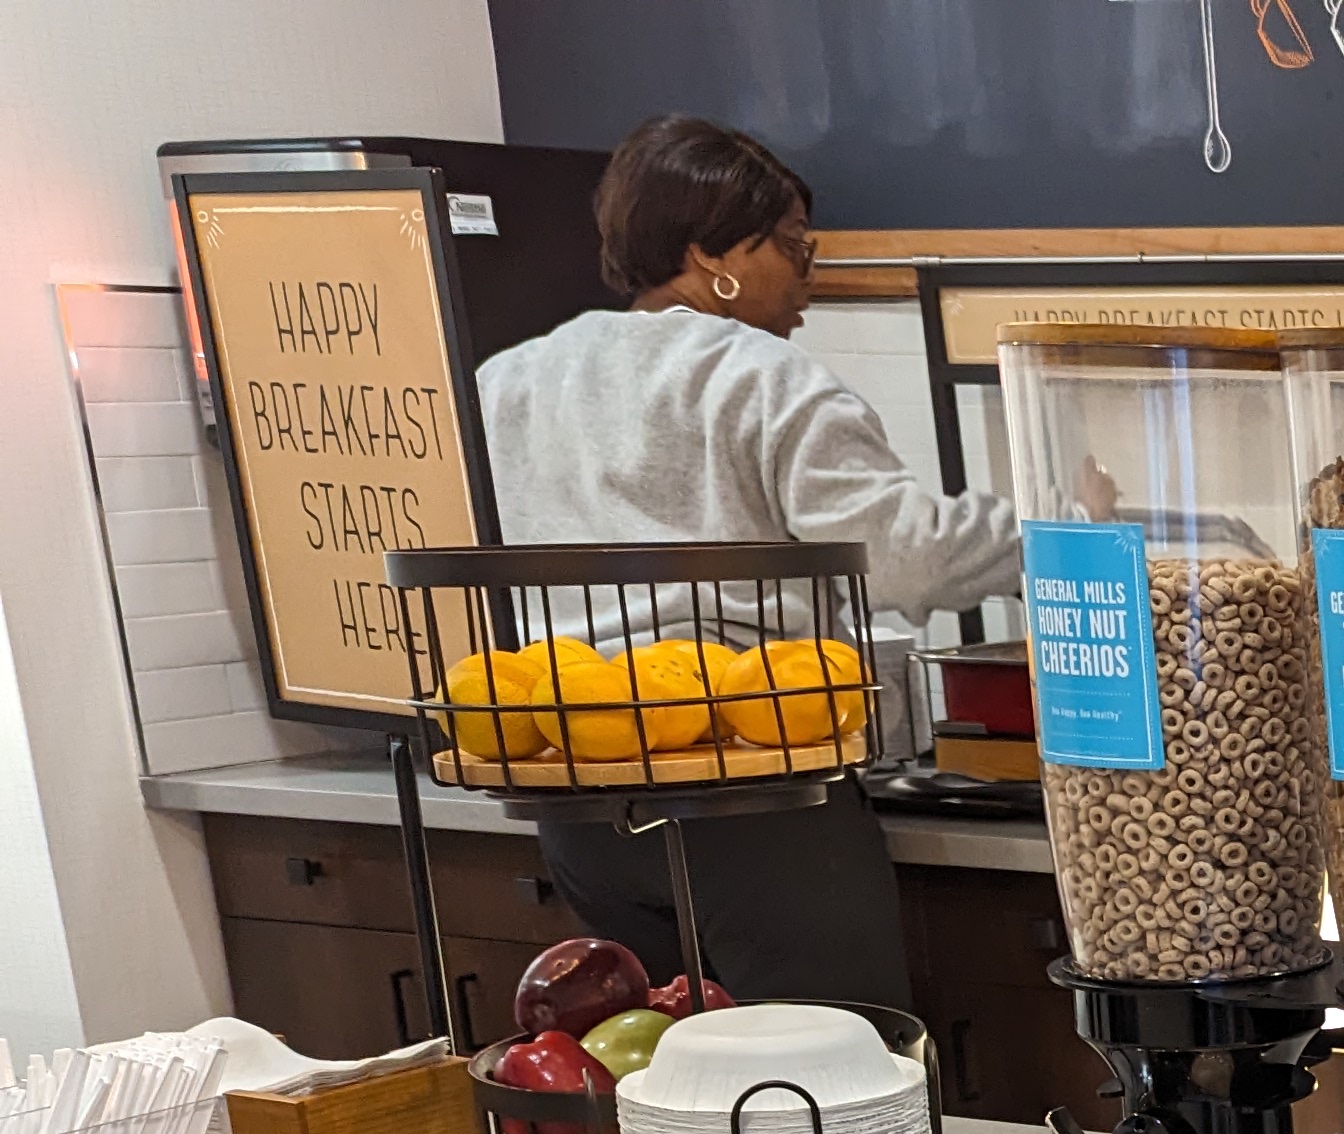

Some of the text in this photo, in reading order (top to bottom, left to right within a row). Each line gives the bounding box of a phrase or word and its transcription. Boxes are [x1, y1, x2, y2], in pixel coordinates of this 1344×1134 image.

[268, 281, 382, 356] HAPPY
[248, 381, 443, 460] BREAKFAST
[300, 481, 427, 554] STARTS
[333, 579, 428, 655] HERE
[1034, 578, 1126, 605] GENERAL MILLS
[1037, 606, 1127, 640] HONEY NUT
[1041, 640, 1130, 678] CHEERIOS
